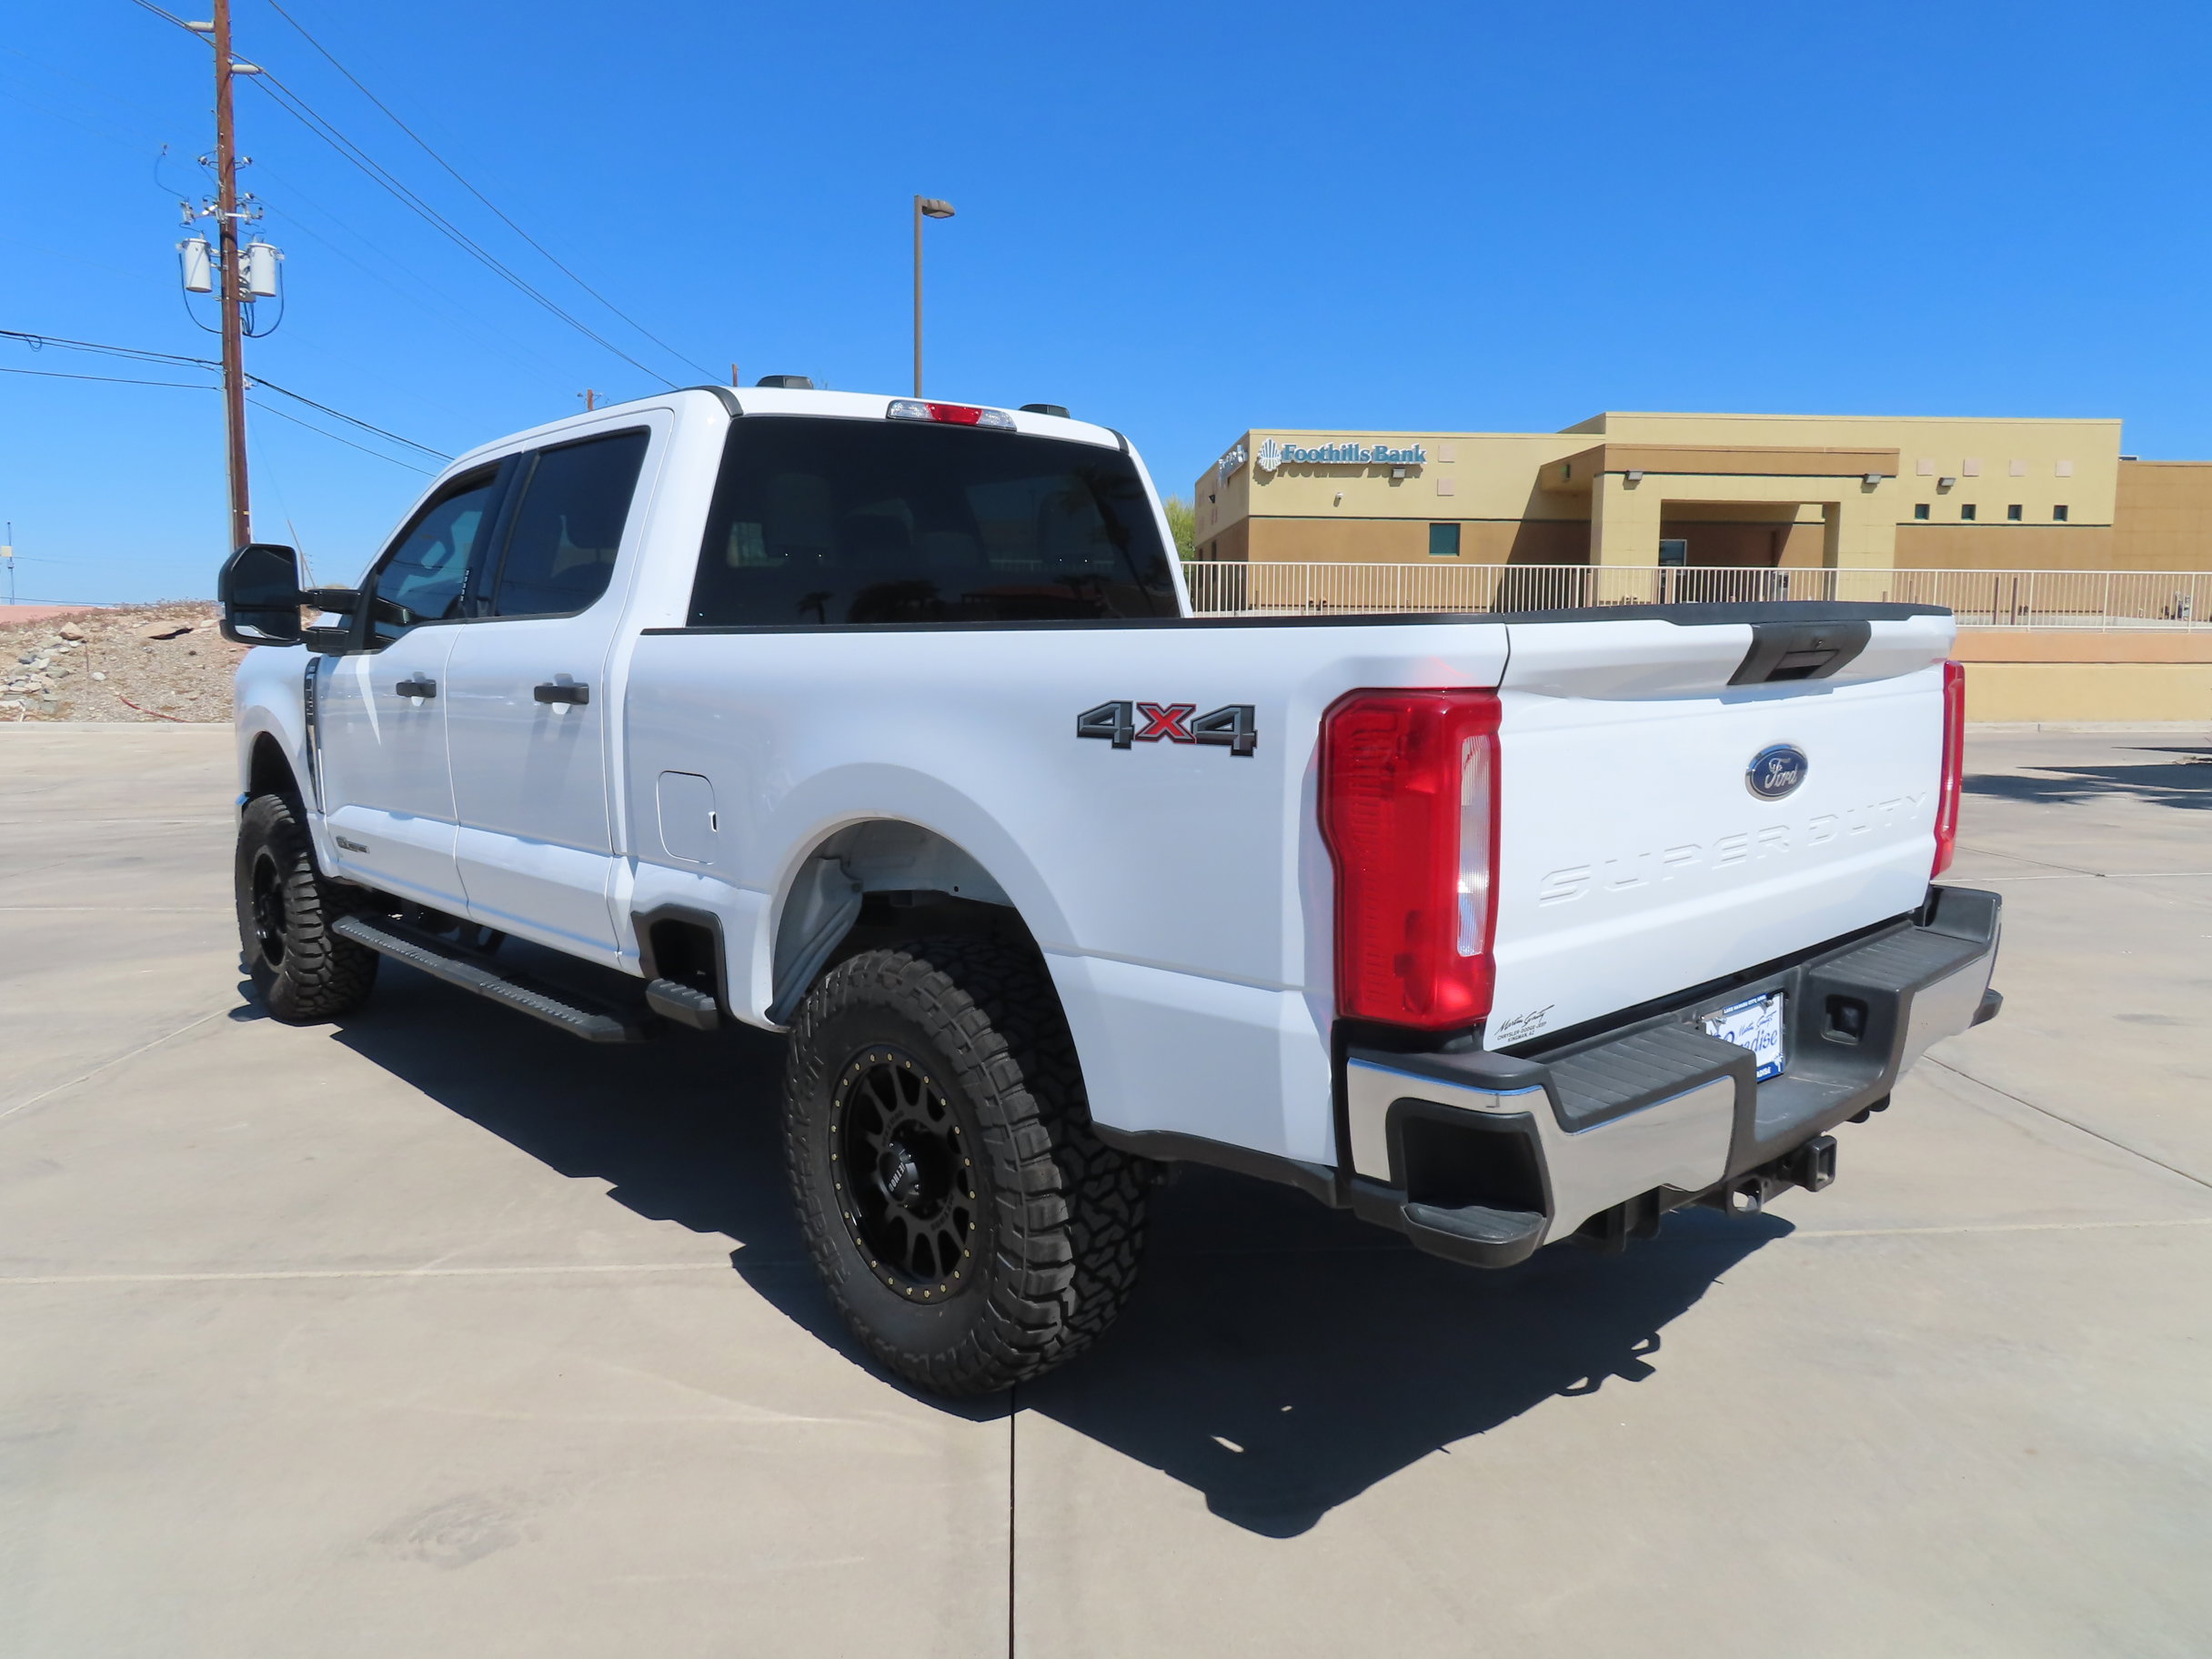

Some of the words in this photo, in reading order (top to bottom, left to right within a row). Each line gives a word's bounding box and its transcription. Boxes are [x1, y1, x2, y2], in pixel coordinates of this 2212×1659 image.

[1281, 442, 1371, 463] Foothills
[1372, 443, 1427, 464] Bank
[1764, 757, 1798, 789] Ford
[1539, 824, 1790, 908] SUPER
[1807, 791, 1926, 847] DUTY
